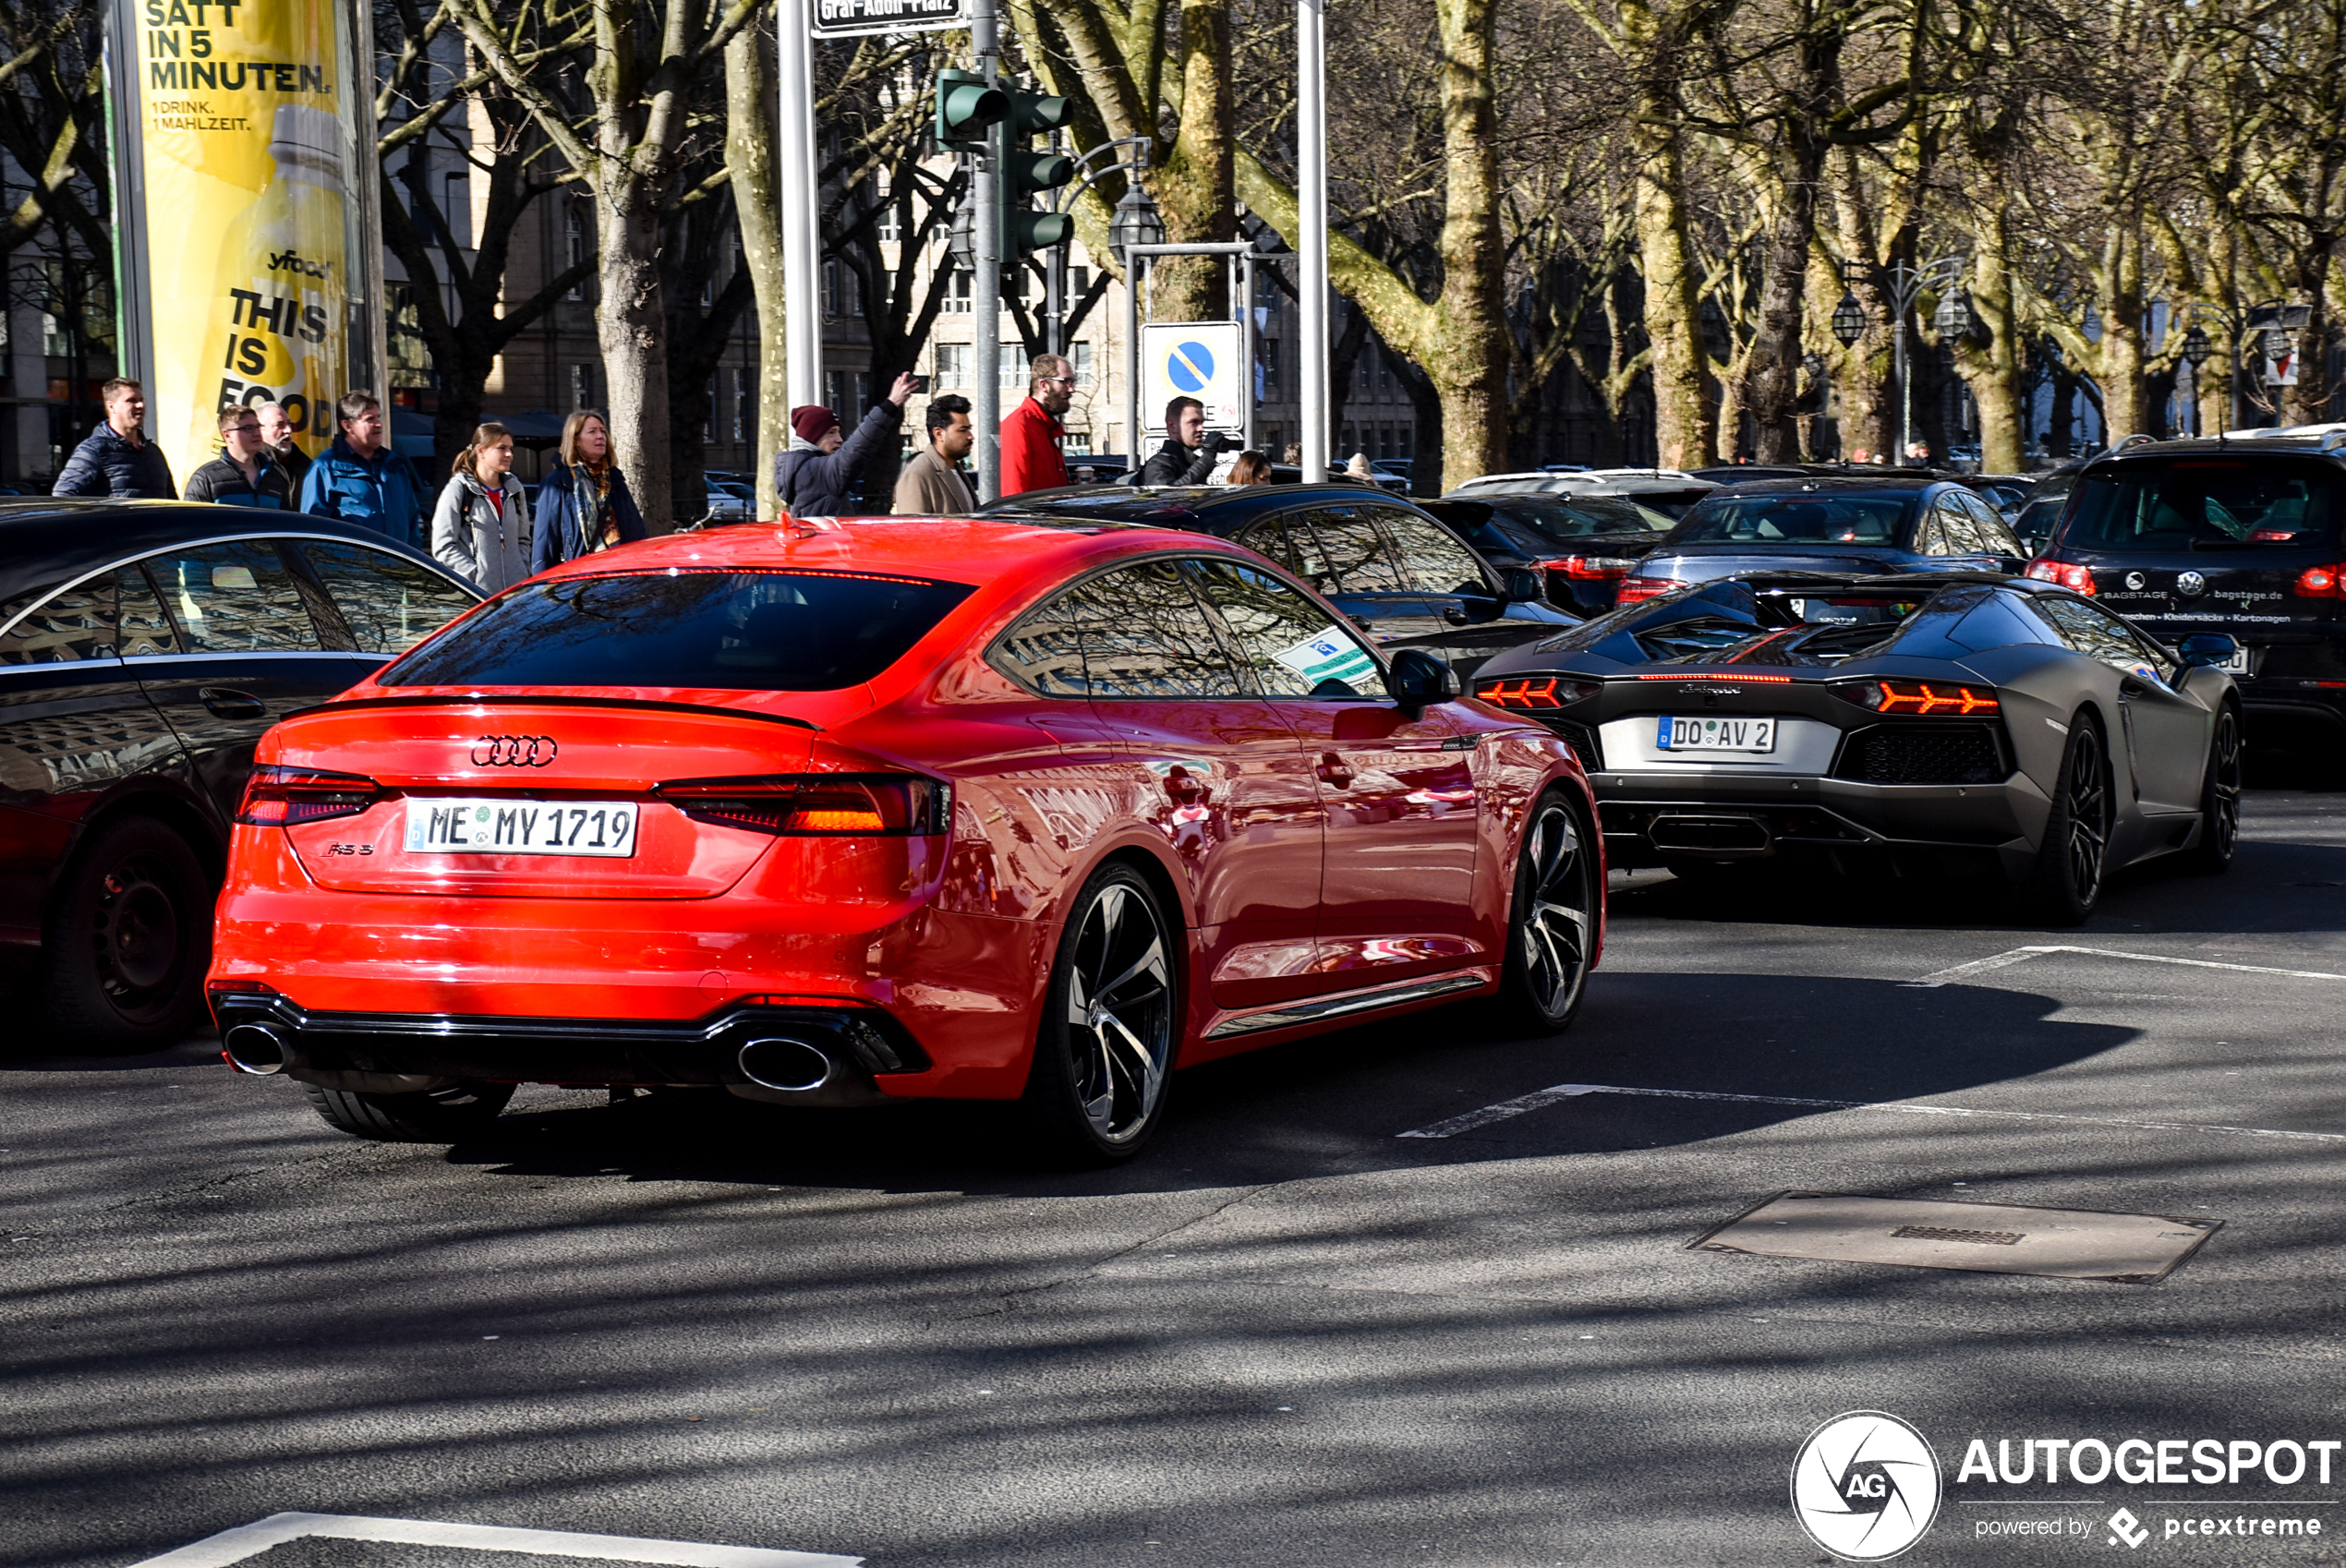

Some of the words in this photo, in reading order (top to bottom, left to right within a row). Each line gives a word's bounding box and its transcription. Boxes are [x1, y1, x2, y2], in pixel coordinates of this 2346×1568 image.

[146, 0, 241, 27] SATT
[149, 30, 181, 58] IN
[190, 30, 212, 58] 5
[230, 287, 328, 344] THIS
[224, 332, 268, 377] IS
[2103, 591, 2169, 600] BAGSTAGE
[2214, 589, 2283, 601] bagstage.de
[2163, 612, 2225, 622] Kleidersäcke
[2232, 613, 2292, 623] Kartonagen
[1673, 720, 1702, 745] DO
[1718, 721, 1747, 746] AV
[1754, 722, 1770, 747] 2
[428, 806, 470, 845] ME
[494, 807, 539, 846] MY
[545, 809, 632, 849] 1719
